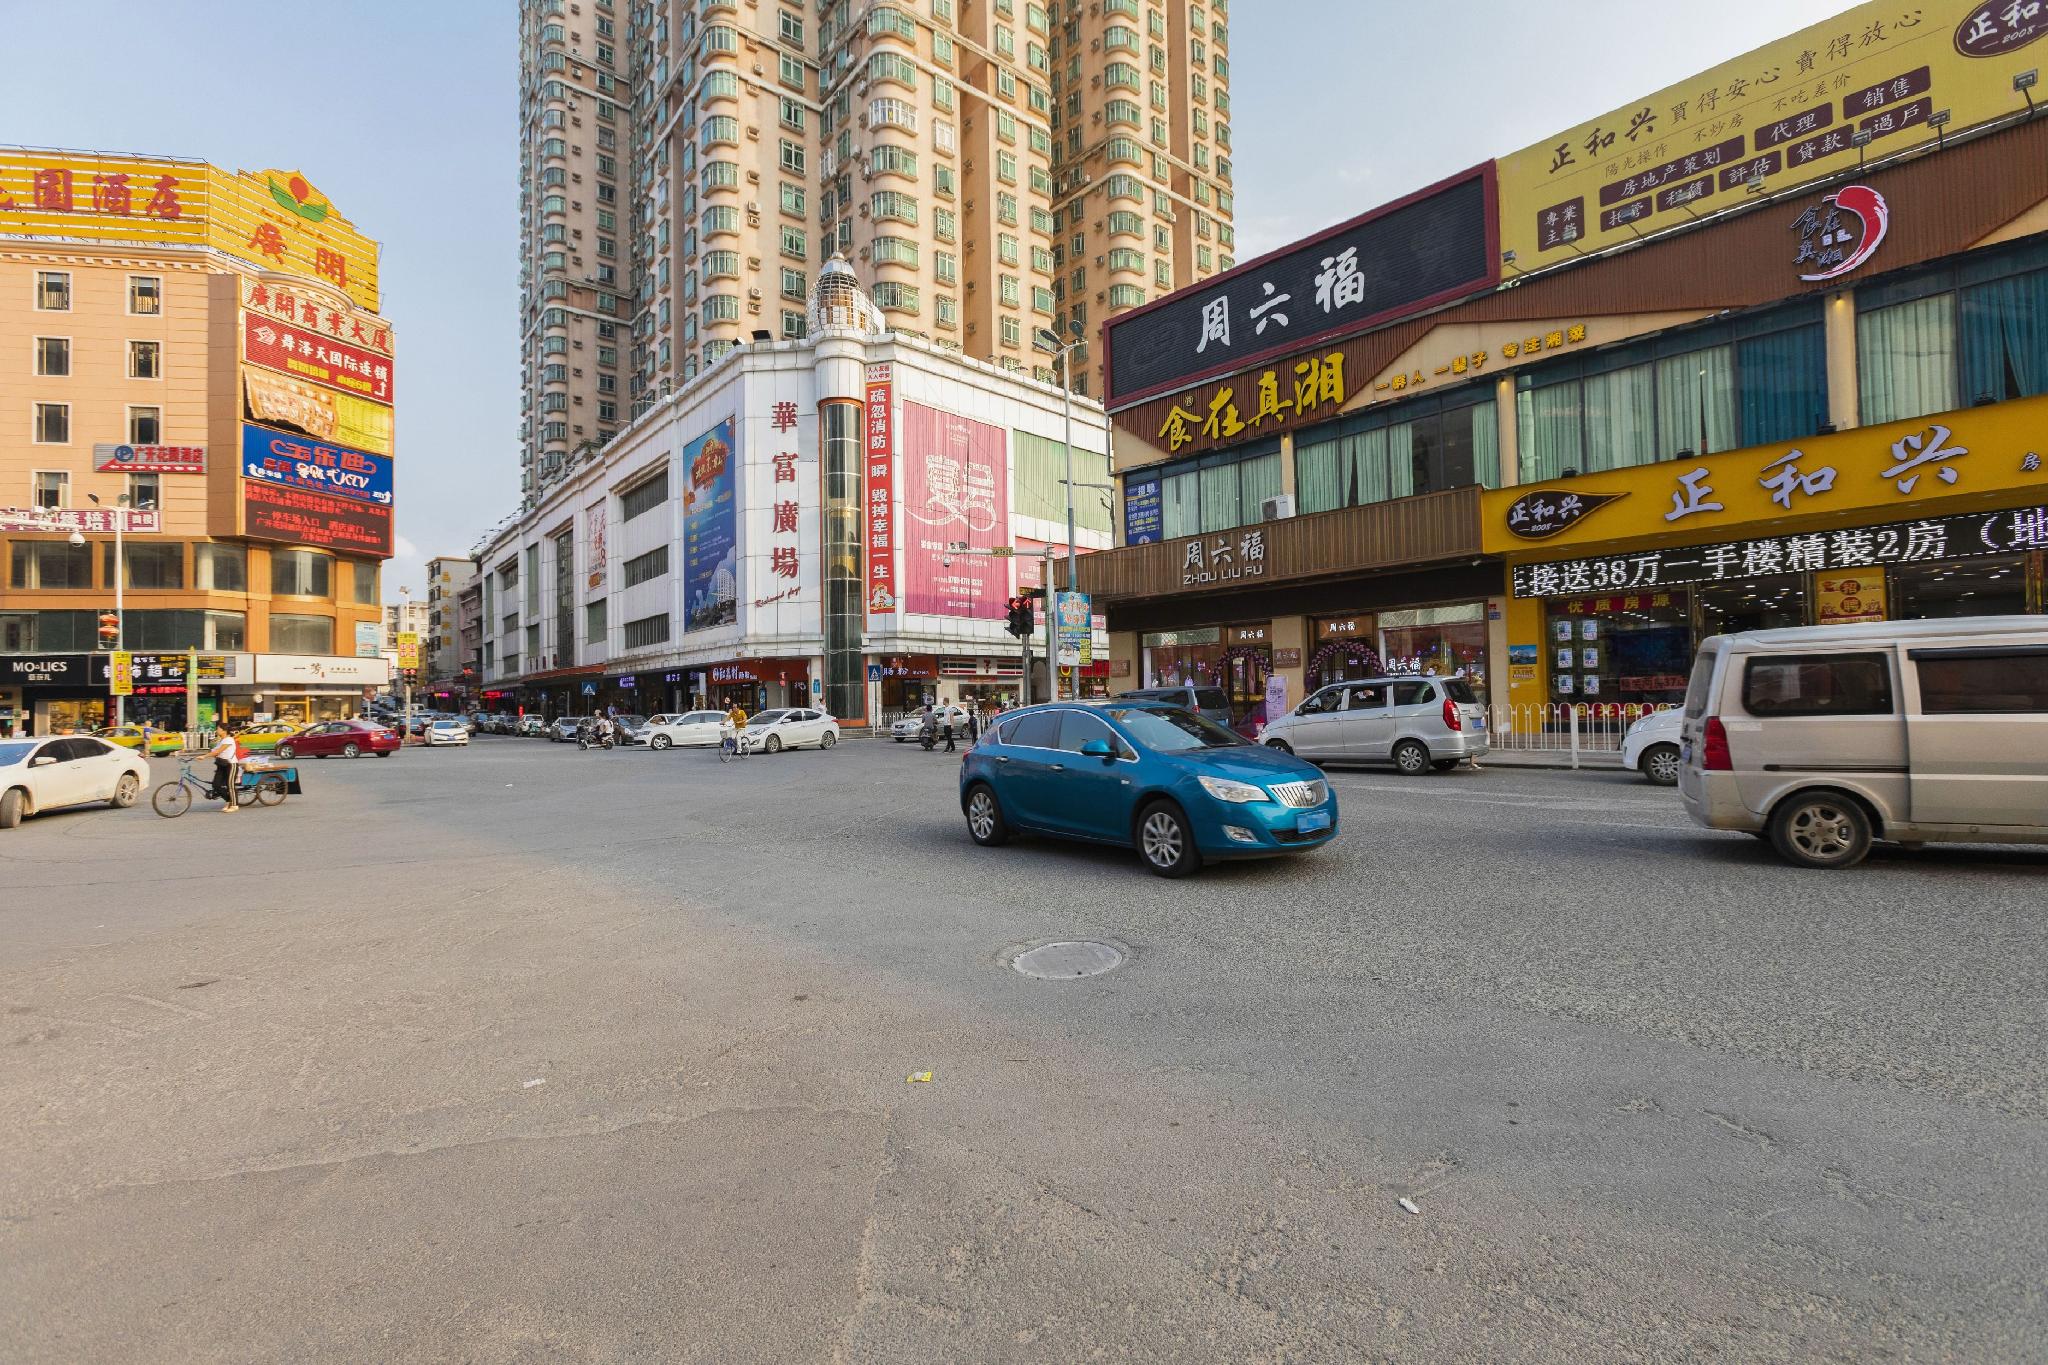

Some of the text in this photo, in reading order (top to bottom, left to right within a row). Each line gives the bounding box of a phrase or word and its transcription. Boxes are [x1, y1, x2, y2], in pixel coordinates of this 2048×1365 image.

[1966, 0, 2048, 46] 正和
[2002, 25, 2036, 44] 2008
[1863, 78, 1910, 108] 销售
[1549, 107, 1658, 175] 正和兴
[1771, 112, 1817, 142] 代理
[1196, 246, 1366, 353] 周六福
[1158, 352, 1345, 451] 食在真湘
[870, 389, 889, 579] 疏忽消防一瞬 毁掉幸福一生
[1664, 425, 1969, 521] 正和兴
[771, 401, 798, 578] 華富廣場
[1509, 494, 1583, 525] 正和兴
[1531, 522, 1553, 532] 2008
[1183, 532, 1265, 569] 周六福
[1183, 564, 1263, 585] ZHOU LIU FU
[1568, 593, 1671, 613] 优质房源
[1841, 581, 1860, 612] 招聘
[1240, 629, 1264, 640] 周六福
[1329, 621, 1356, 633] 周六福
[1387, 657, 1421, 672] 周六福
